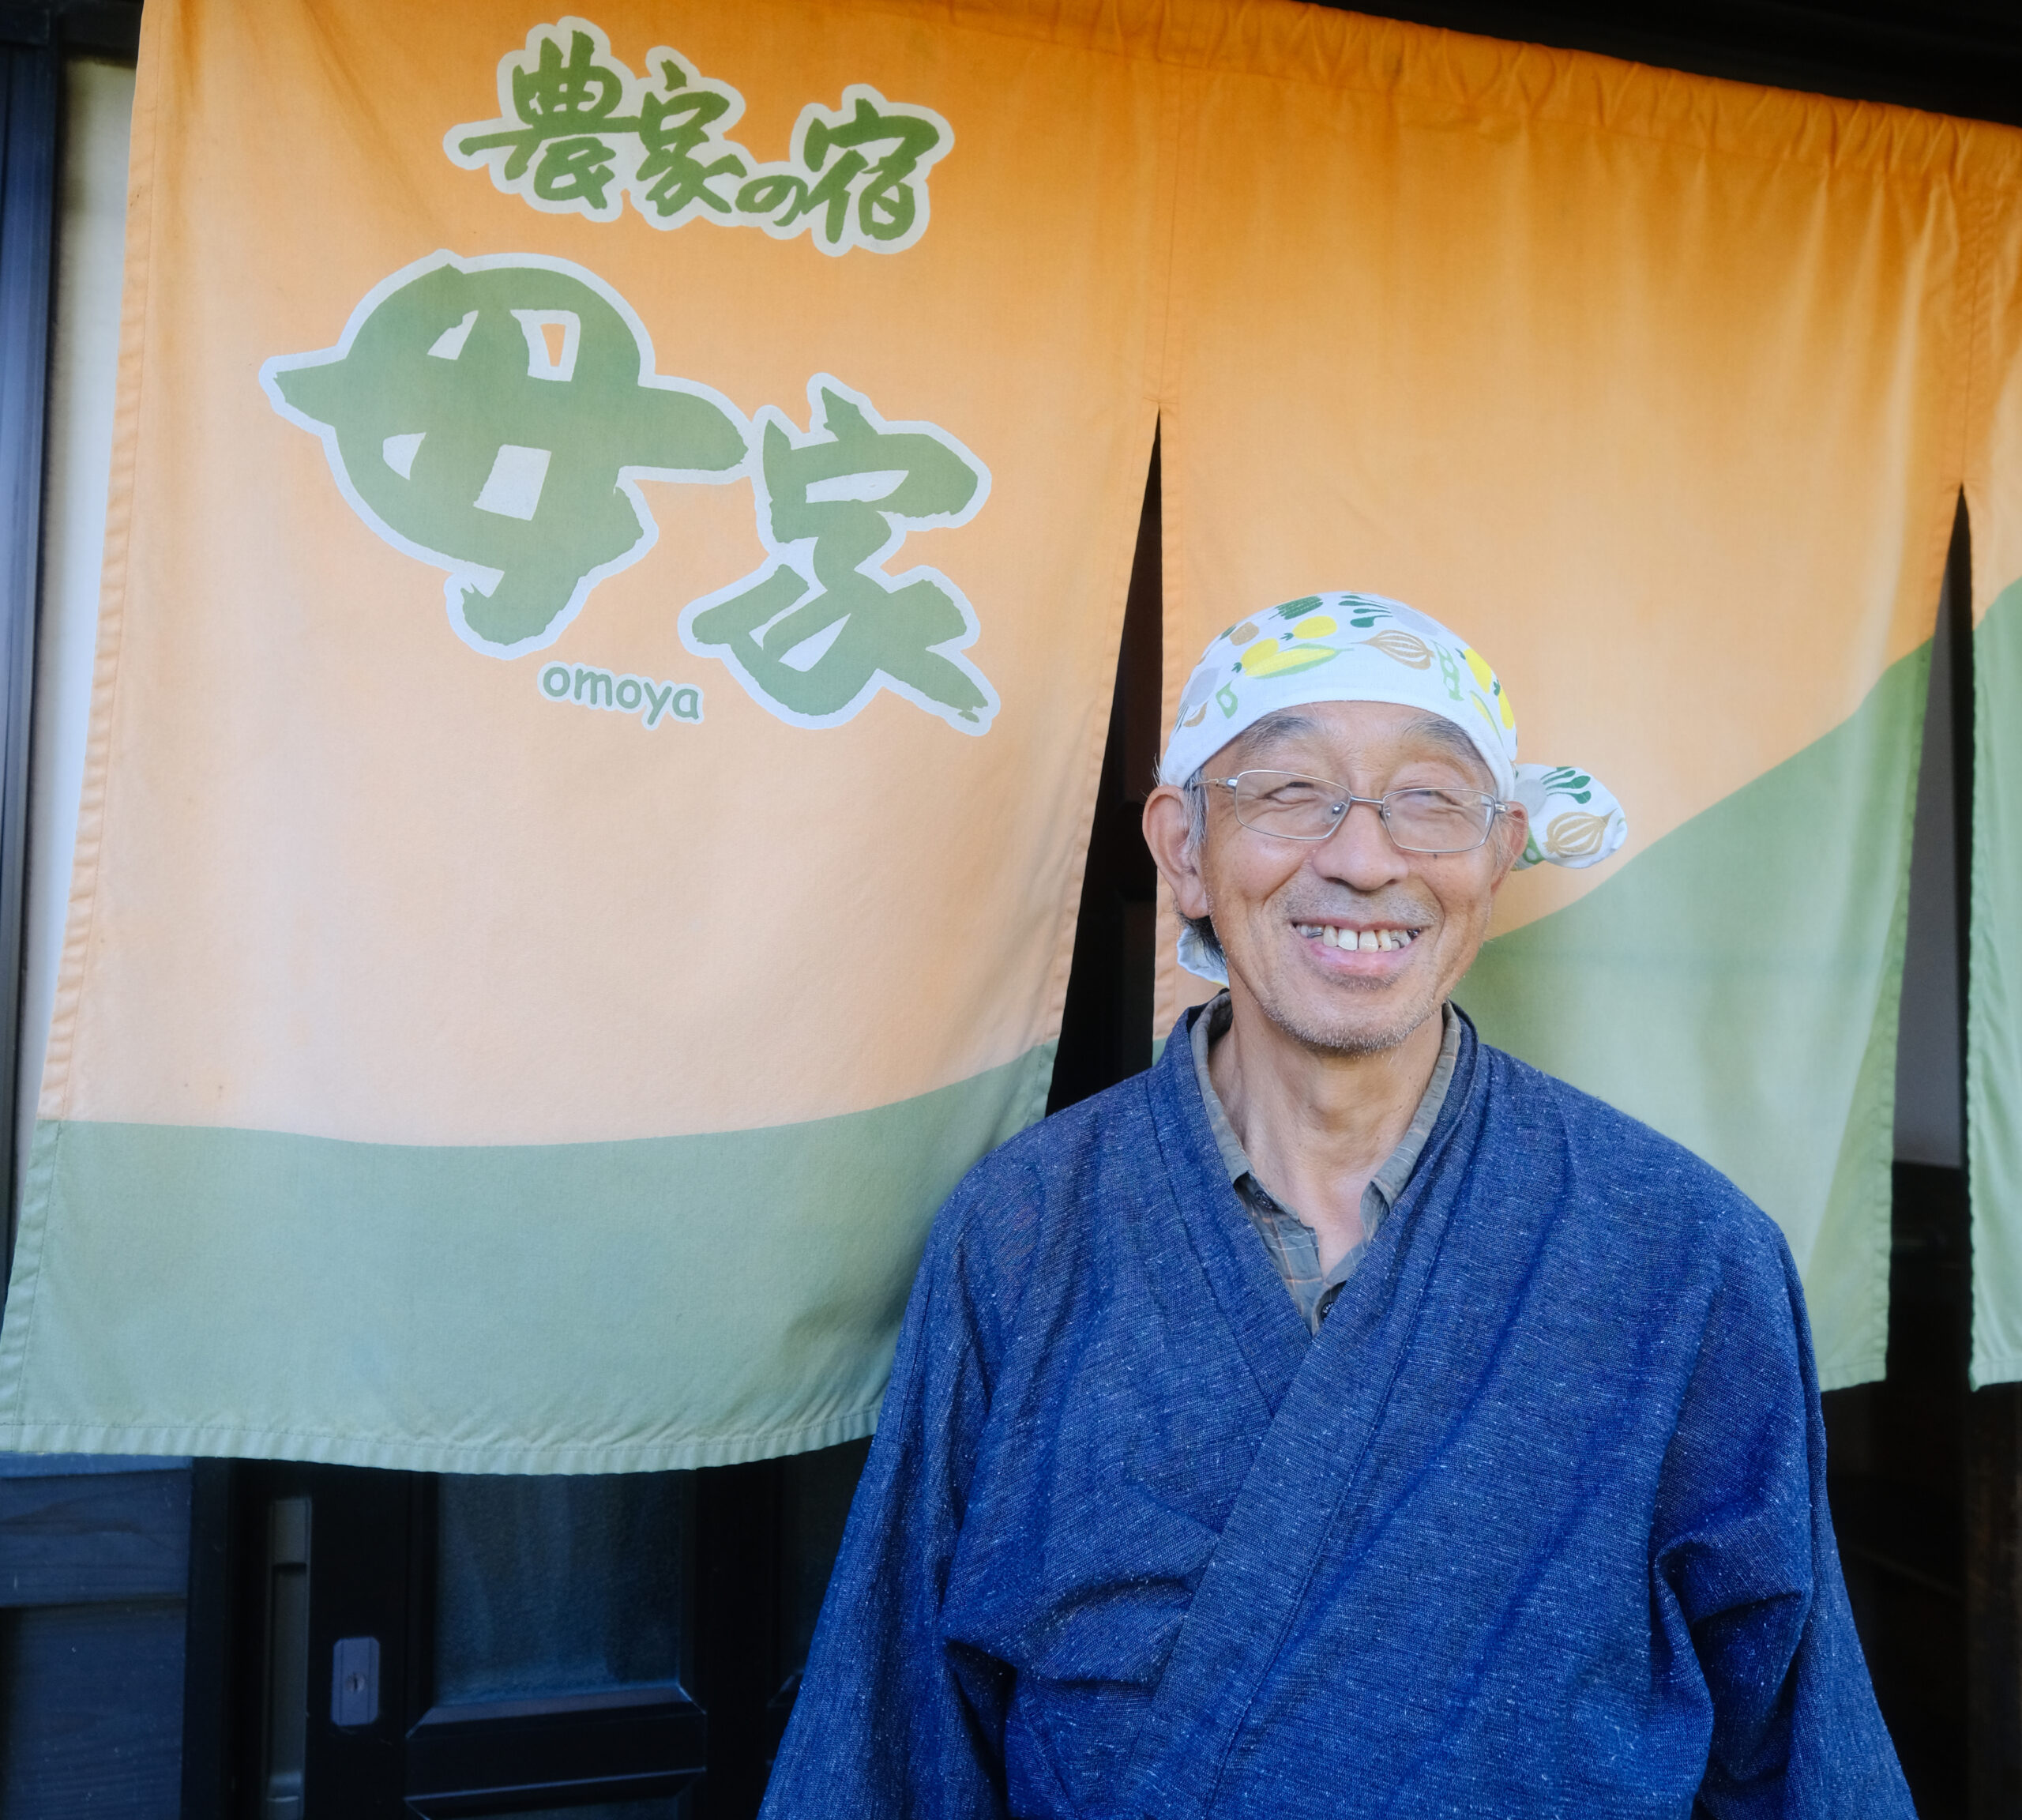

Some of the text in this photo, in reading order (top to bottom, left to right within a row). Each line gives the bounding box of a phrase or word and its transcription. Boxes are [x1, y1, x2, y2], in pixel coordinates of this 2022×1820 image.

[458, 29, 941, 243] 農家の宿
[272, 262, 989, 723] 母家
[543, 666, 700, 726] omoya
